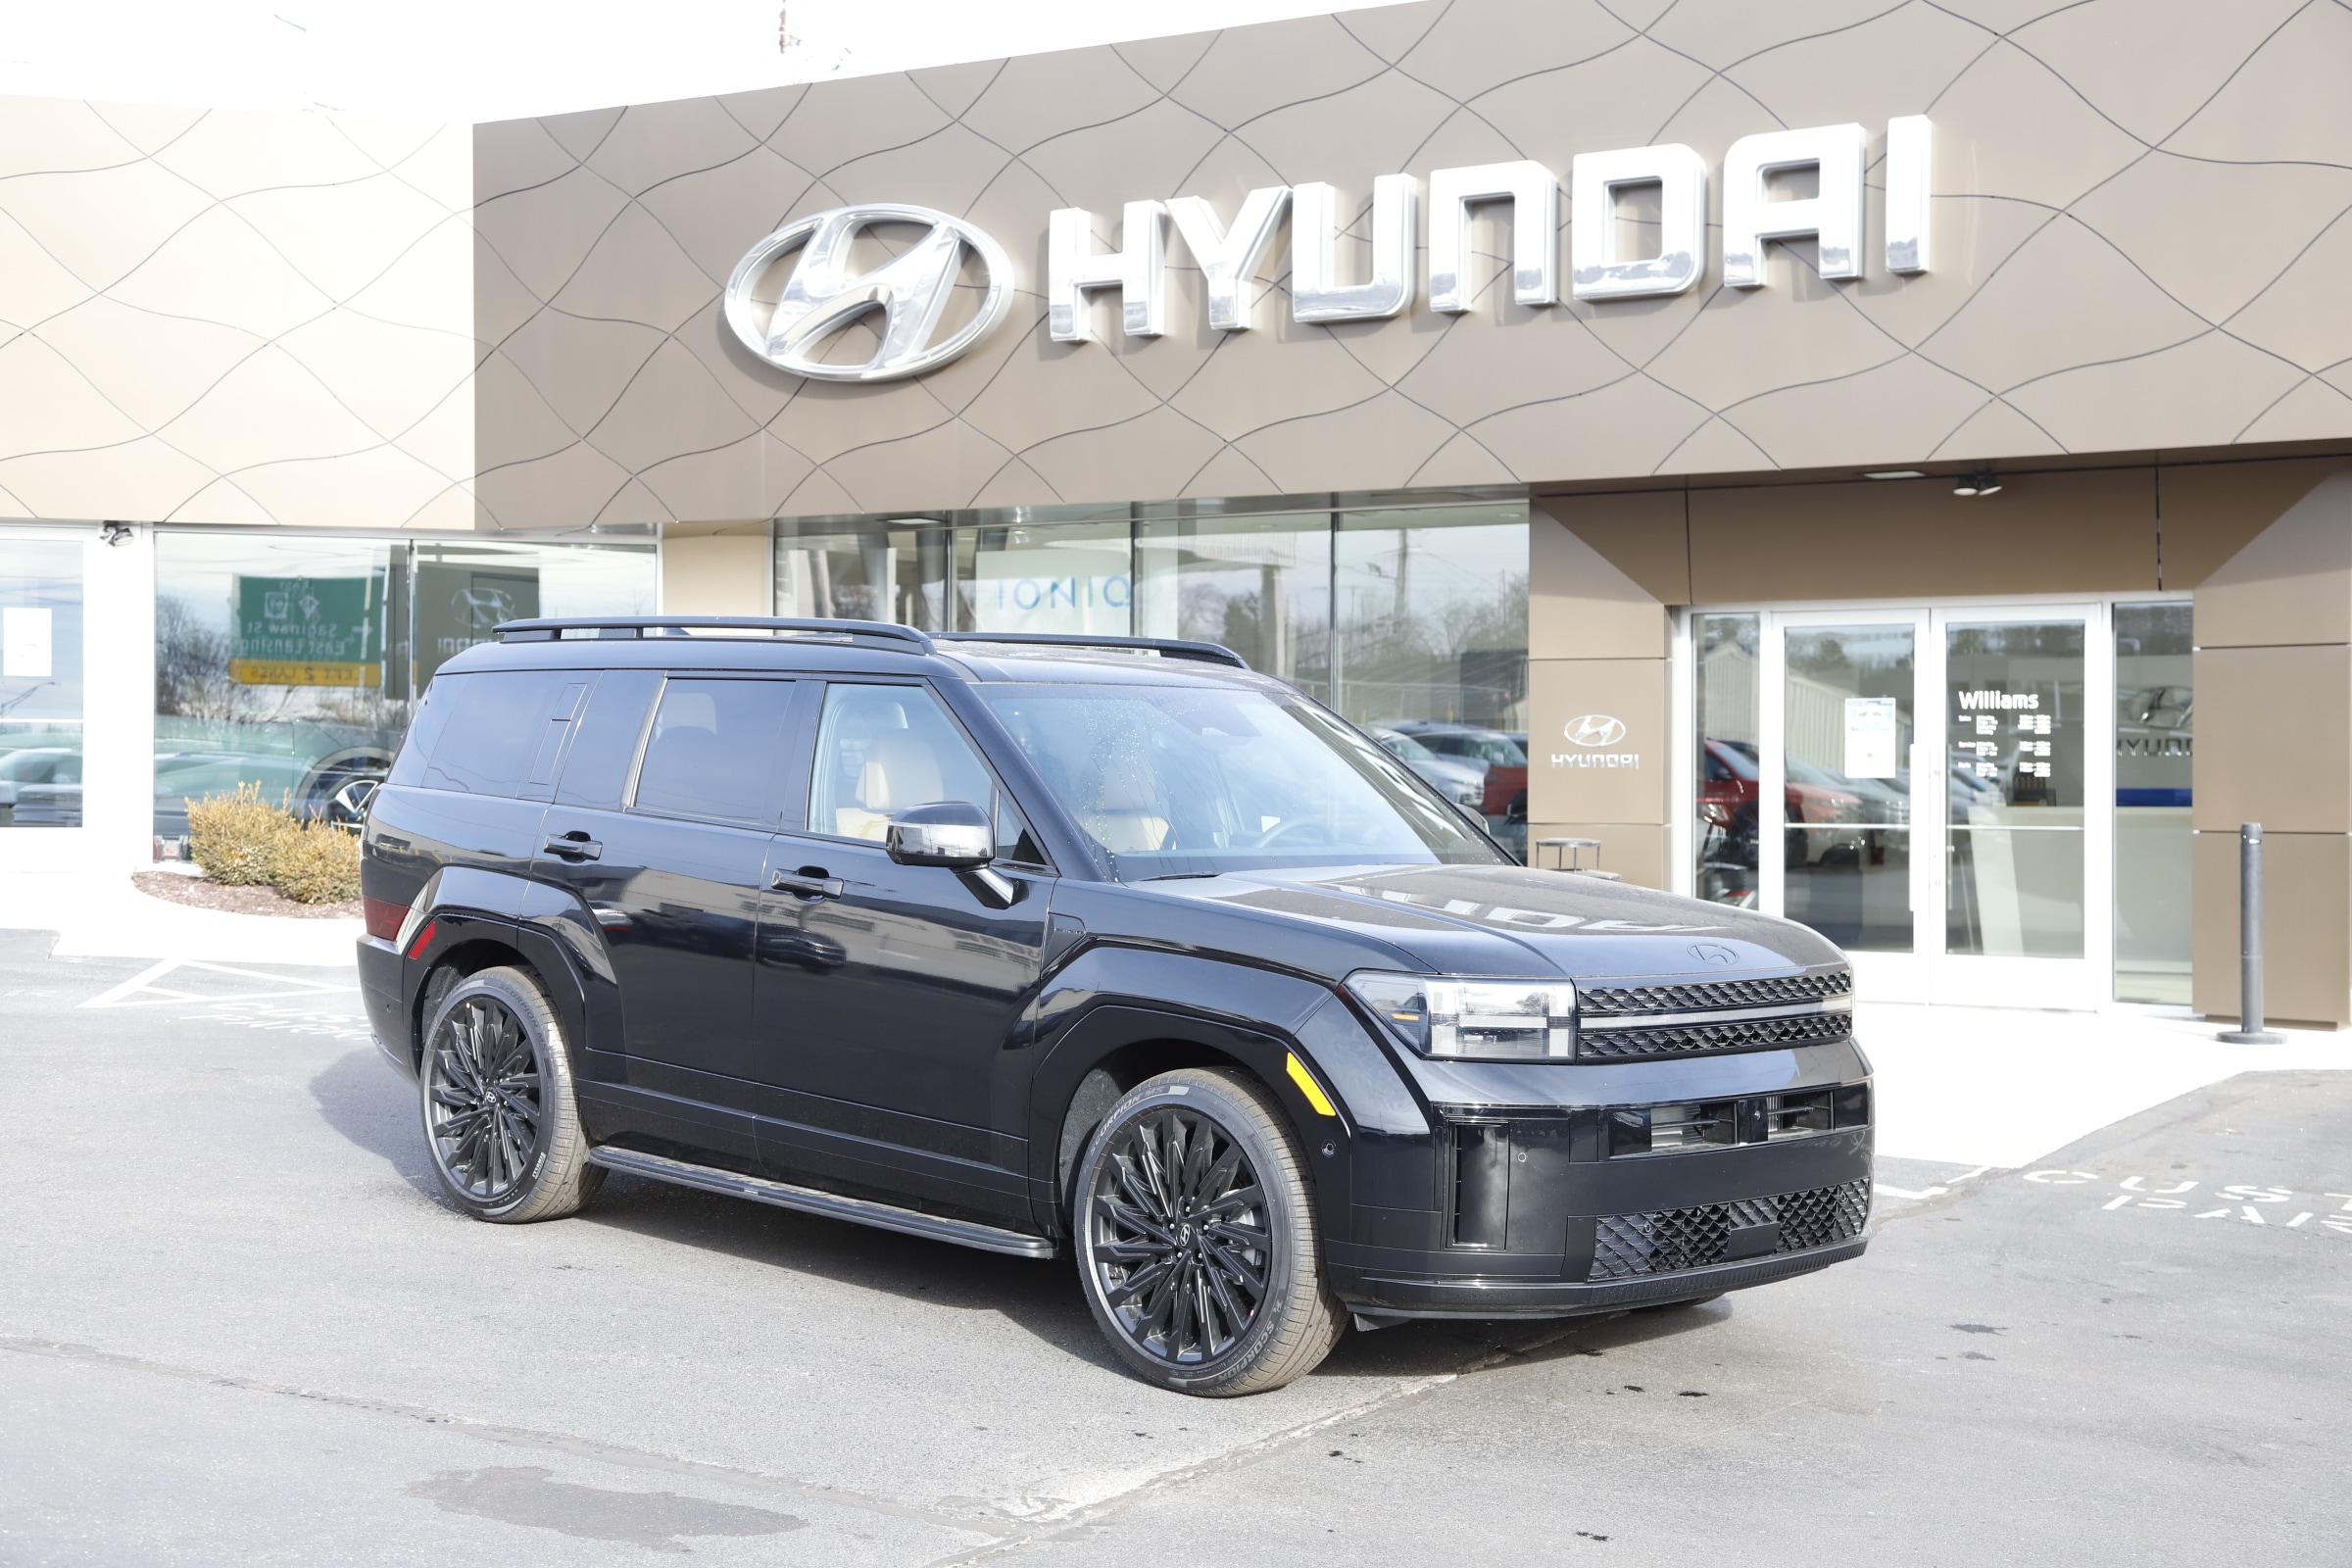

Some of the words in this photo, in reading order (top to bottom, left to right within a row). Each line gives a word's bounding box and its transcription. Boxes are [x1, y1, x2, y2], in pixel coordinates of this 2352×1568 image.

[1048, 114, 1934, 342] HYUNDAI
[998, 574, 1131, 611] IONIQ
[1959, 690, 2038, 710] Williams
[1550, 754, 1640, 769] HYUNDAI
[1090, 1094, 1141, 1156] SCORPION
